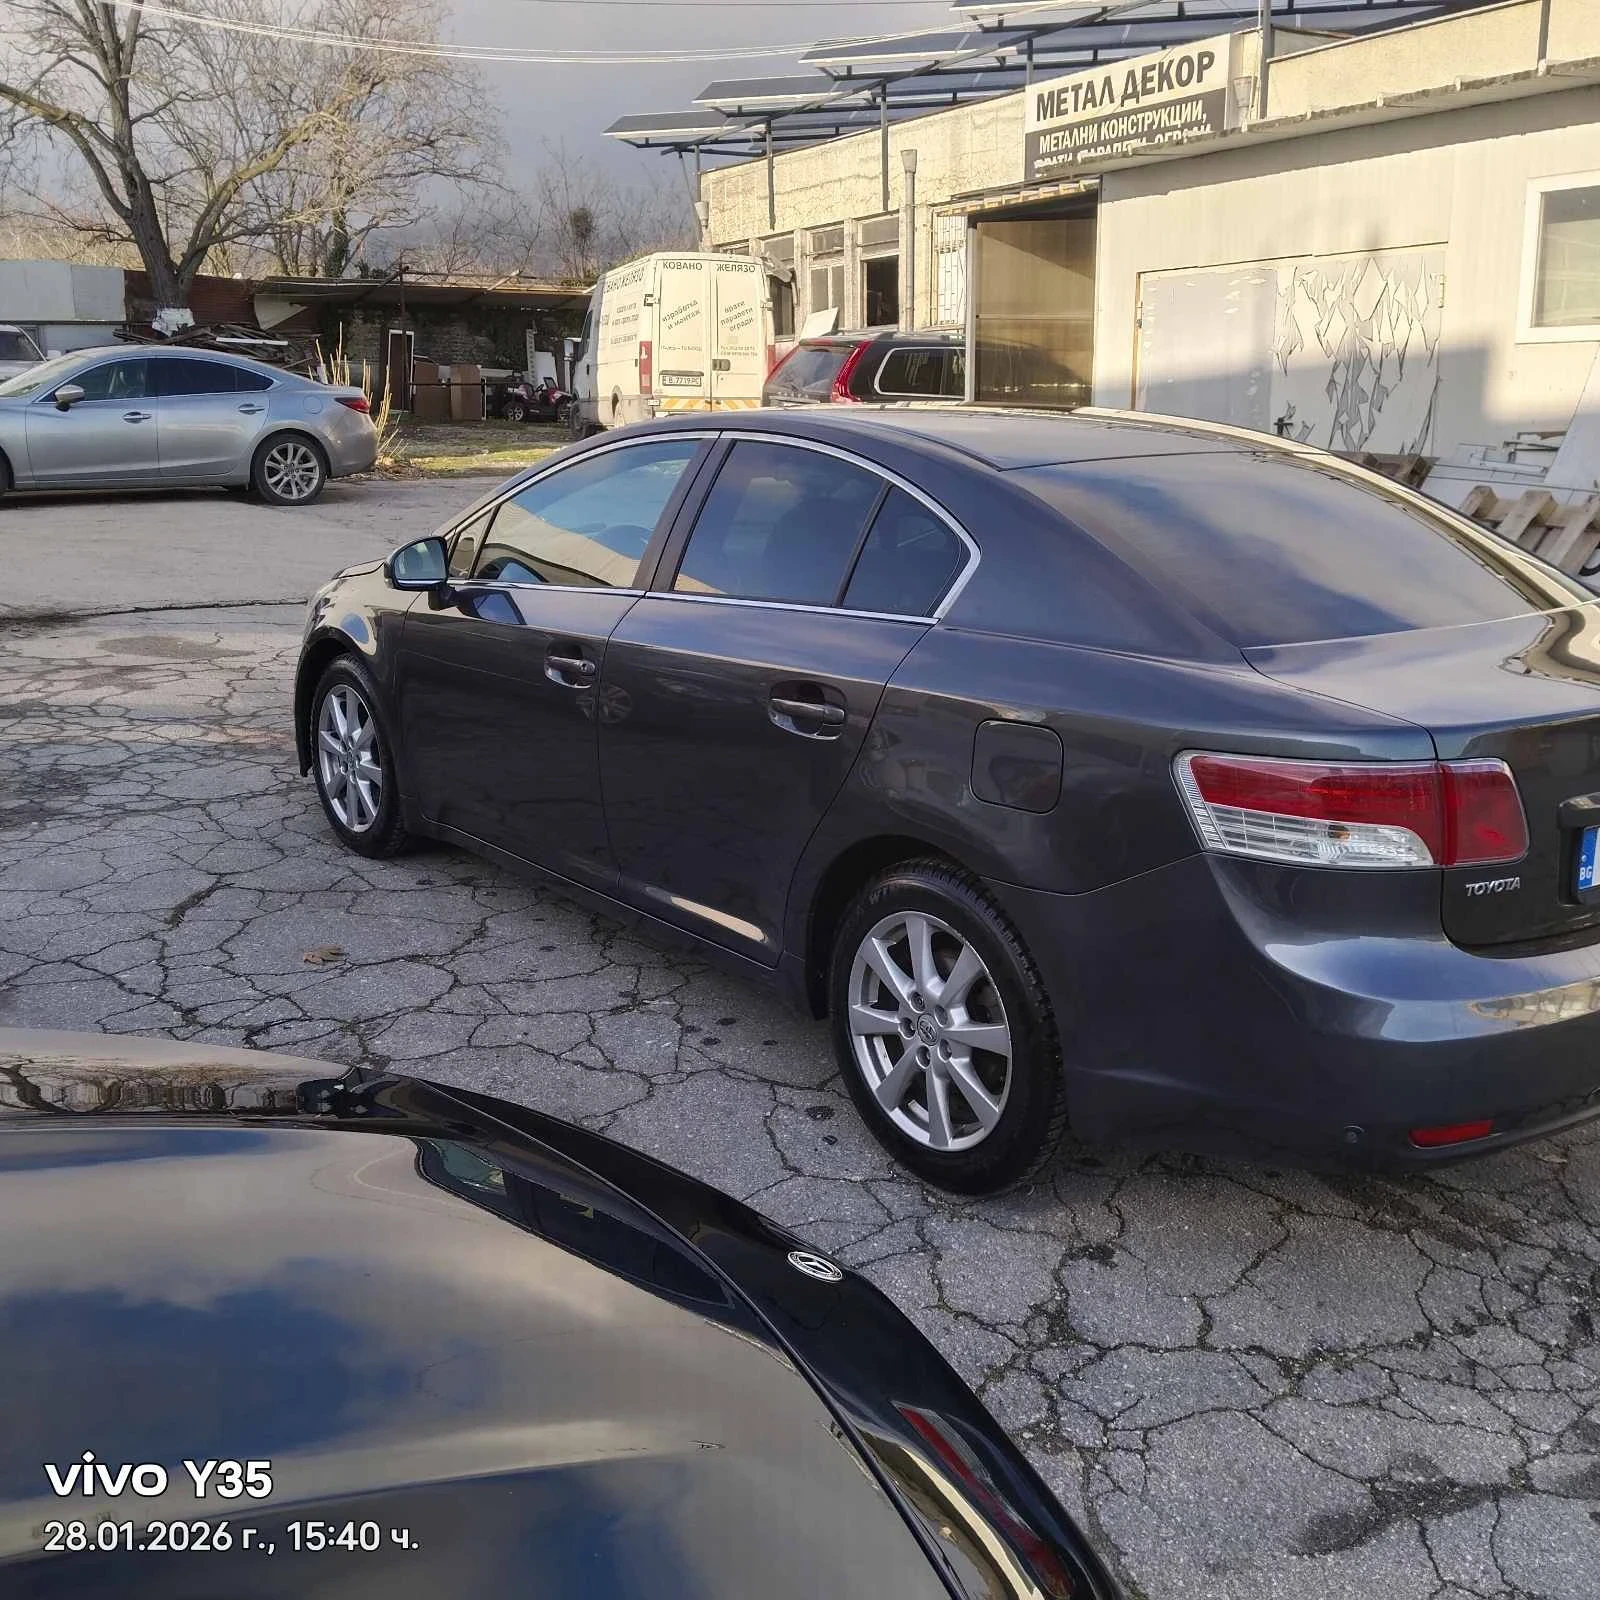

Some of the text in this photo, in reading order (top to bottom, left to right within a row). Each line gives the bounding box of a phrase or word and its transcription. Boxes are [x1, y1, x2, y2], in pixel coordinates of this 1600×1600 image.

[1037, 50, 1215, 121] МЕТАЛ ДЕКОР
[1040, 100, 1207, 154] МЕТАЛНИ КОНСТРУКЦИИ,
[662, 261, 756, 273] КОВАНО ЖЕЛЯЗО
[1579, 866, 1593, 880] BG
[1465, 876, 1520, 897] TOYOTA
